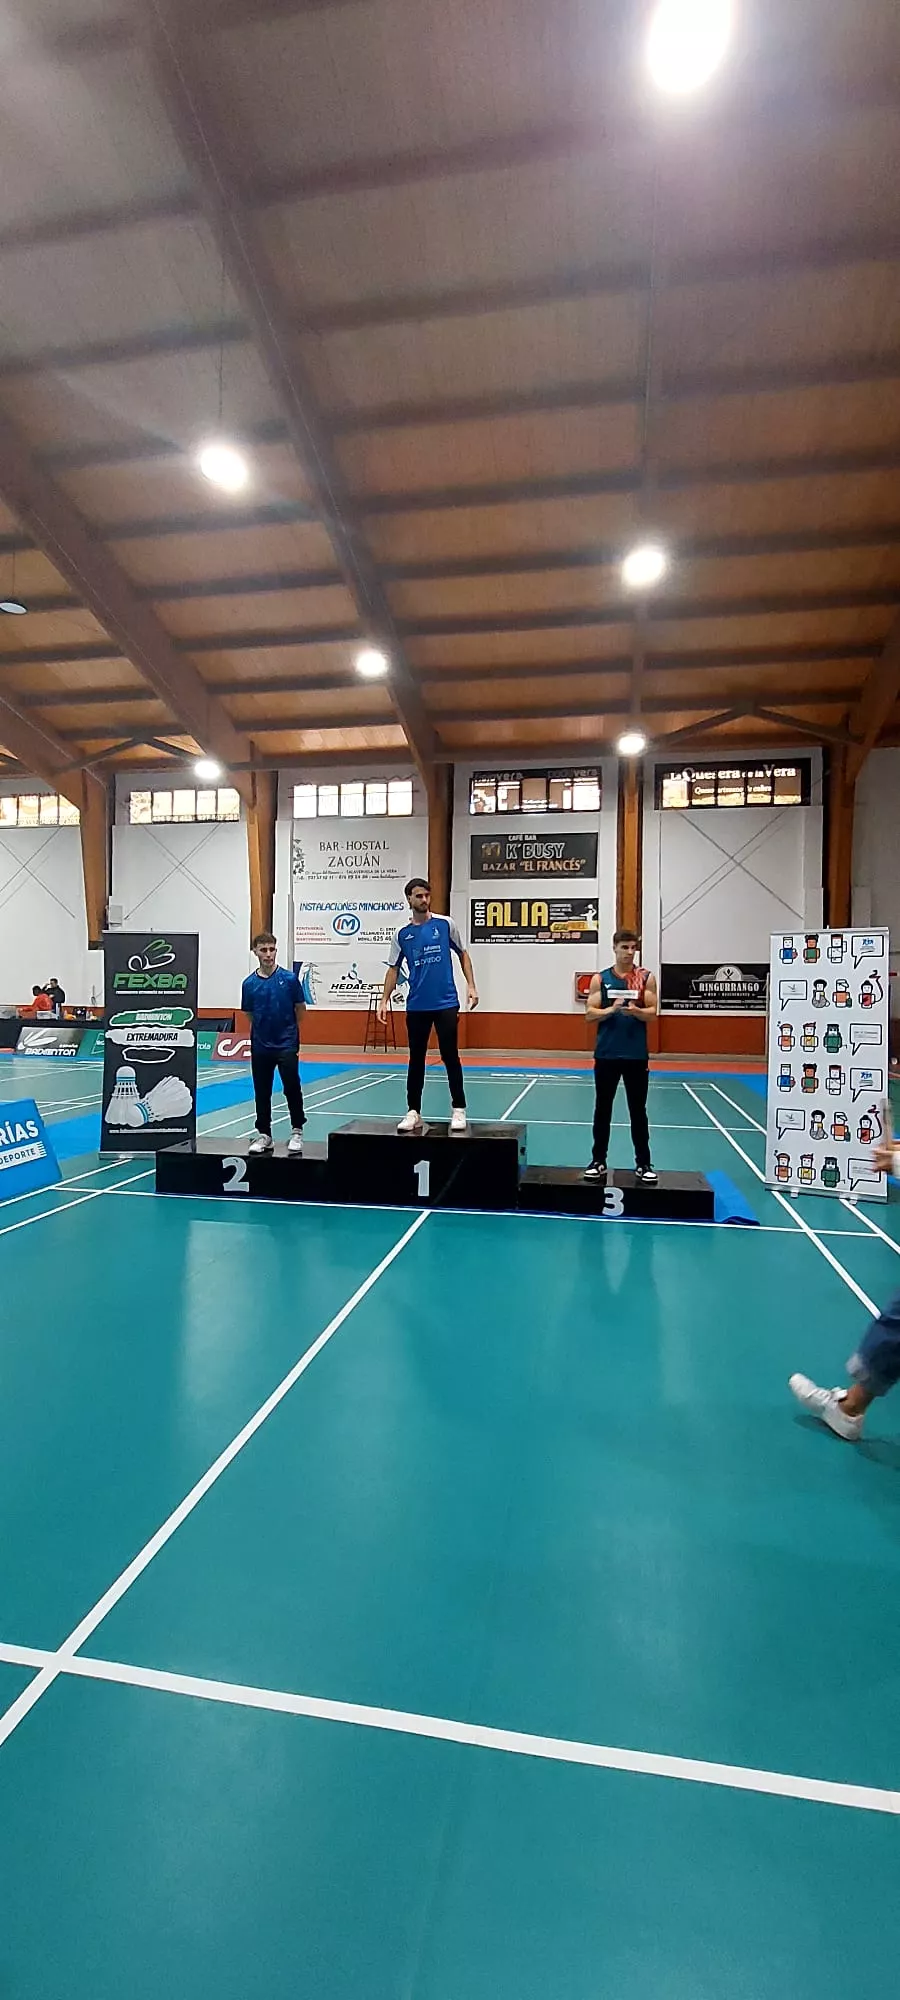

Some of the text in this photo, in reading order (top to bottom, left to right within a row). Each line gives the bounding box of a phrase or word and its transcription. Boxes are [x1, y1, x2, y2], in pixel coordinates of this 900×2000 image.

[319, 841, 339, 852] BAR
[346, 840, 390, 850] HOSTAL
[328, 853, 380, 868] ZAGUÁN
[482, 862, 516, 872] BAZAR
[299, 901, 405, 912] INSTALACIONES MINCHONES
[486, 901, 549, 927] ALIA
[474, 902, 486, 927] BAR
[113, 973, 188, 989] FEXBA
[330, 983, 374, 991] HEDAES
[126, 1032, 179, 1042] EXTREMADURA
[221, 1157, 250, 1192] 2
[413, 1160, 430, 1197] 1
[602, 1186, 624, 1217] 3
